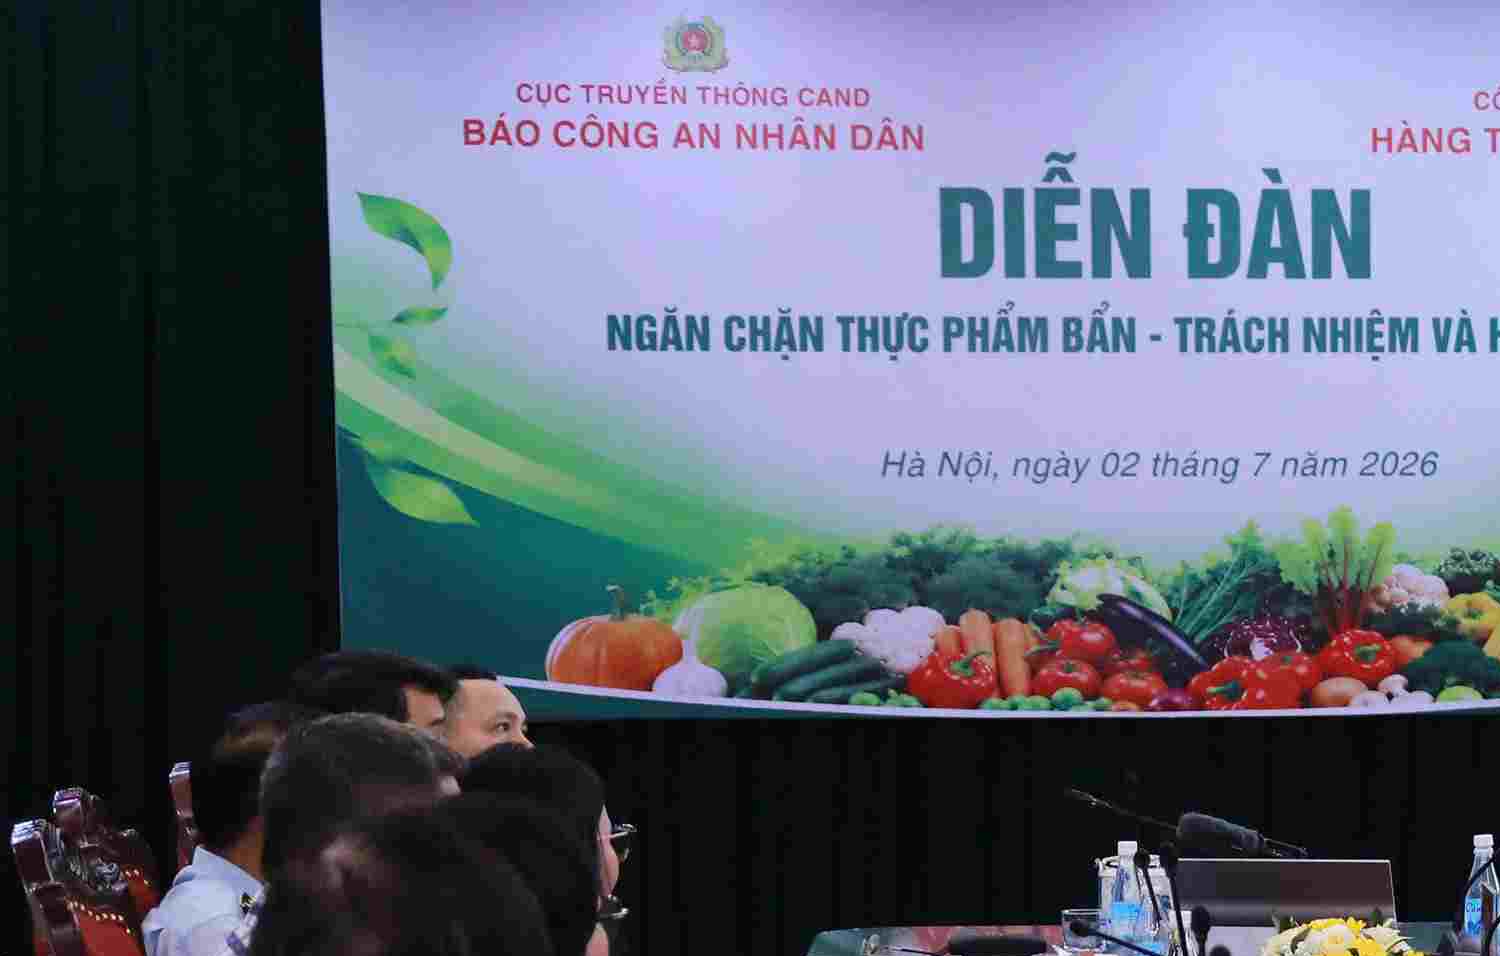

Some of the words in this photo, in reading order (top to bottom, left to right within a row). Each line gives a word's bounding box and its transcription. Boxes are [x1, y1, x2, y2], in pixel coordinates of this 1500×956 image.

[516, 82, 572, 109] CỤC
[695, 81, 789, 107] THÔNG
[797, 87, 872, 108] CAND
[463, 112, 541, 147] BÁO
[552, 112, 659, 149] CÔNG
[672, 121, 721, 150] AN
[735, 115, 837, 151] NHÂN
[850, 116, 926, 151] DÂN
[1370, 120, 1472, 154] HÀNG
[938, 151, 1152, 280] DIỄN
[1182, 168, 1373, 280] ĐÀN
[606, 305, 711, 353] NGĂN
[723, 305, 825, 361] CHẶN
[835, 311, 930, 361] THỰC
[941, 300, 1049, 354] PHẨM
[1061, 300, 1137, 354] BẨN
[1149, 332, 1163, 343] -
[1172, 308, 1291, 354] TRÁCH
[1301, 309, 1420, 362] NHIỆM
[1430, 309, 1478, 354] VÀ
[880, 451, 925, 479] Hà
[936, 450, 1000, 482] Nội,
[1011, 450, 1090, 485] ngày
[1100, 451, 1141, 479] 02
[1150, 450, 1240, 485] tháng
[1251, 452, 1272, 479] 7
[1280, 452, 1349, 479] năm
[1358, 451, 1440, 479] 2026
